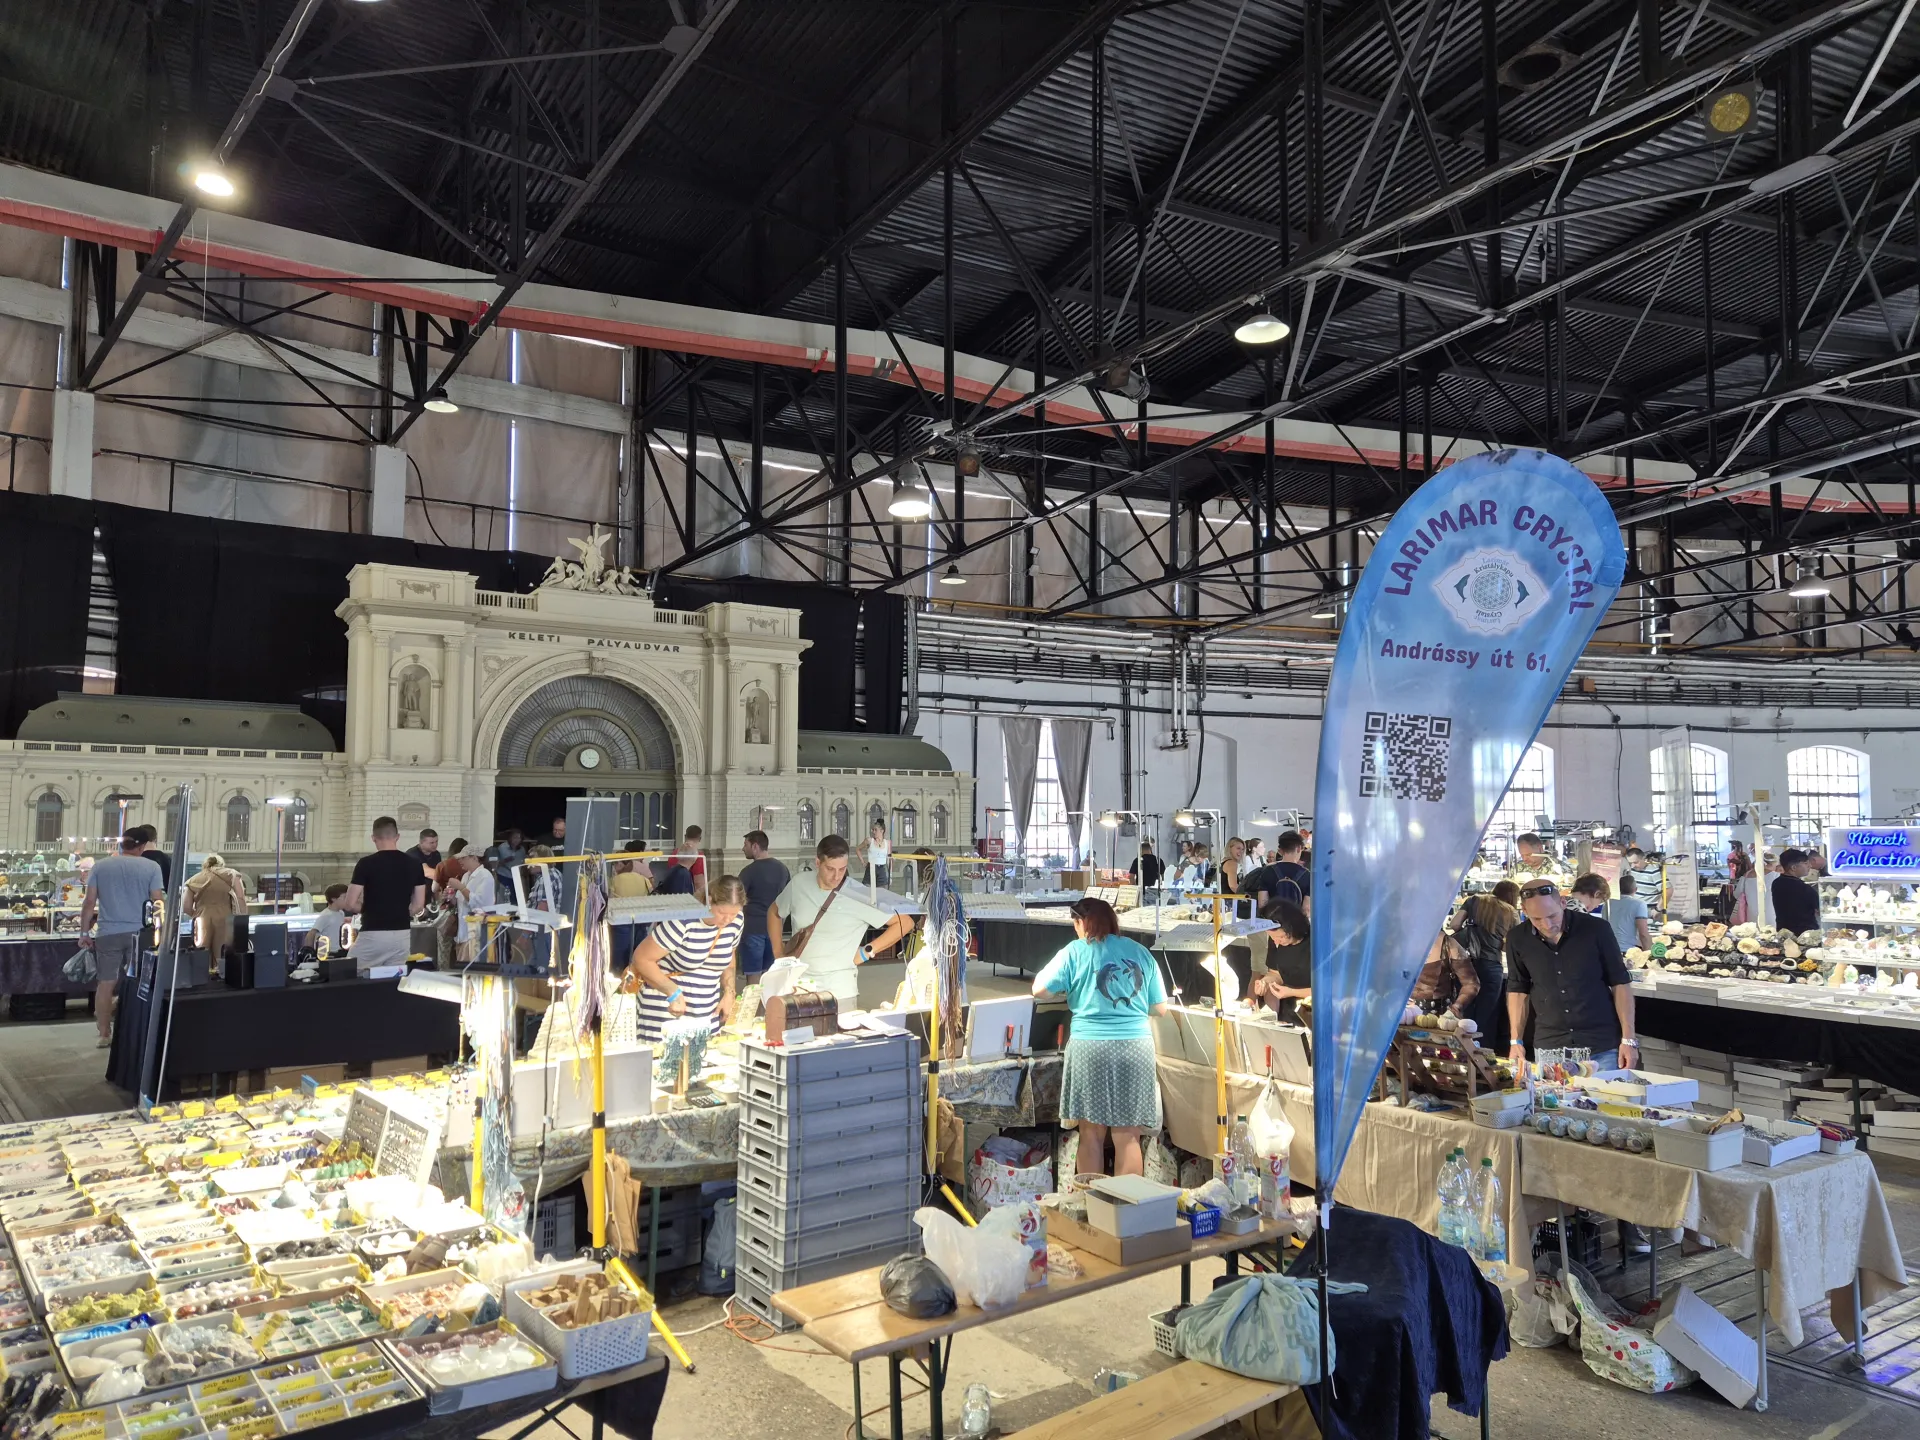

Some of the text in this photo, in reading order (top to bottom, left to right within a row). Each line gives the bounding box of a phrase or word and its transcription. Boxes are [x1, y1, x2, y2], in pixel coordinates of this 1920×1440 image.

[1385, 499, 1595, 615] LARIMAR CRYSTAL
[1482, 557, 1510, 566] Larimar
[1473, 562, 1514, 578] Kristálykapu
[508, 631, 681, 653] KELETI PÁLYAUDVAR
[1380, 639, 1552, 673] Andrássy út 61.
[1848, 831, 1908, 846] Németh
